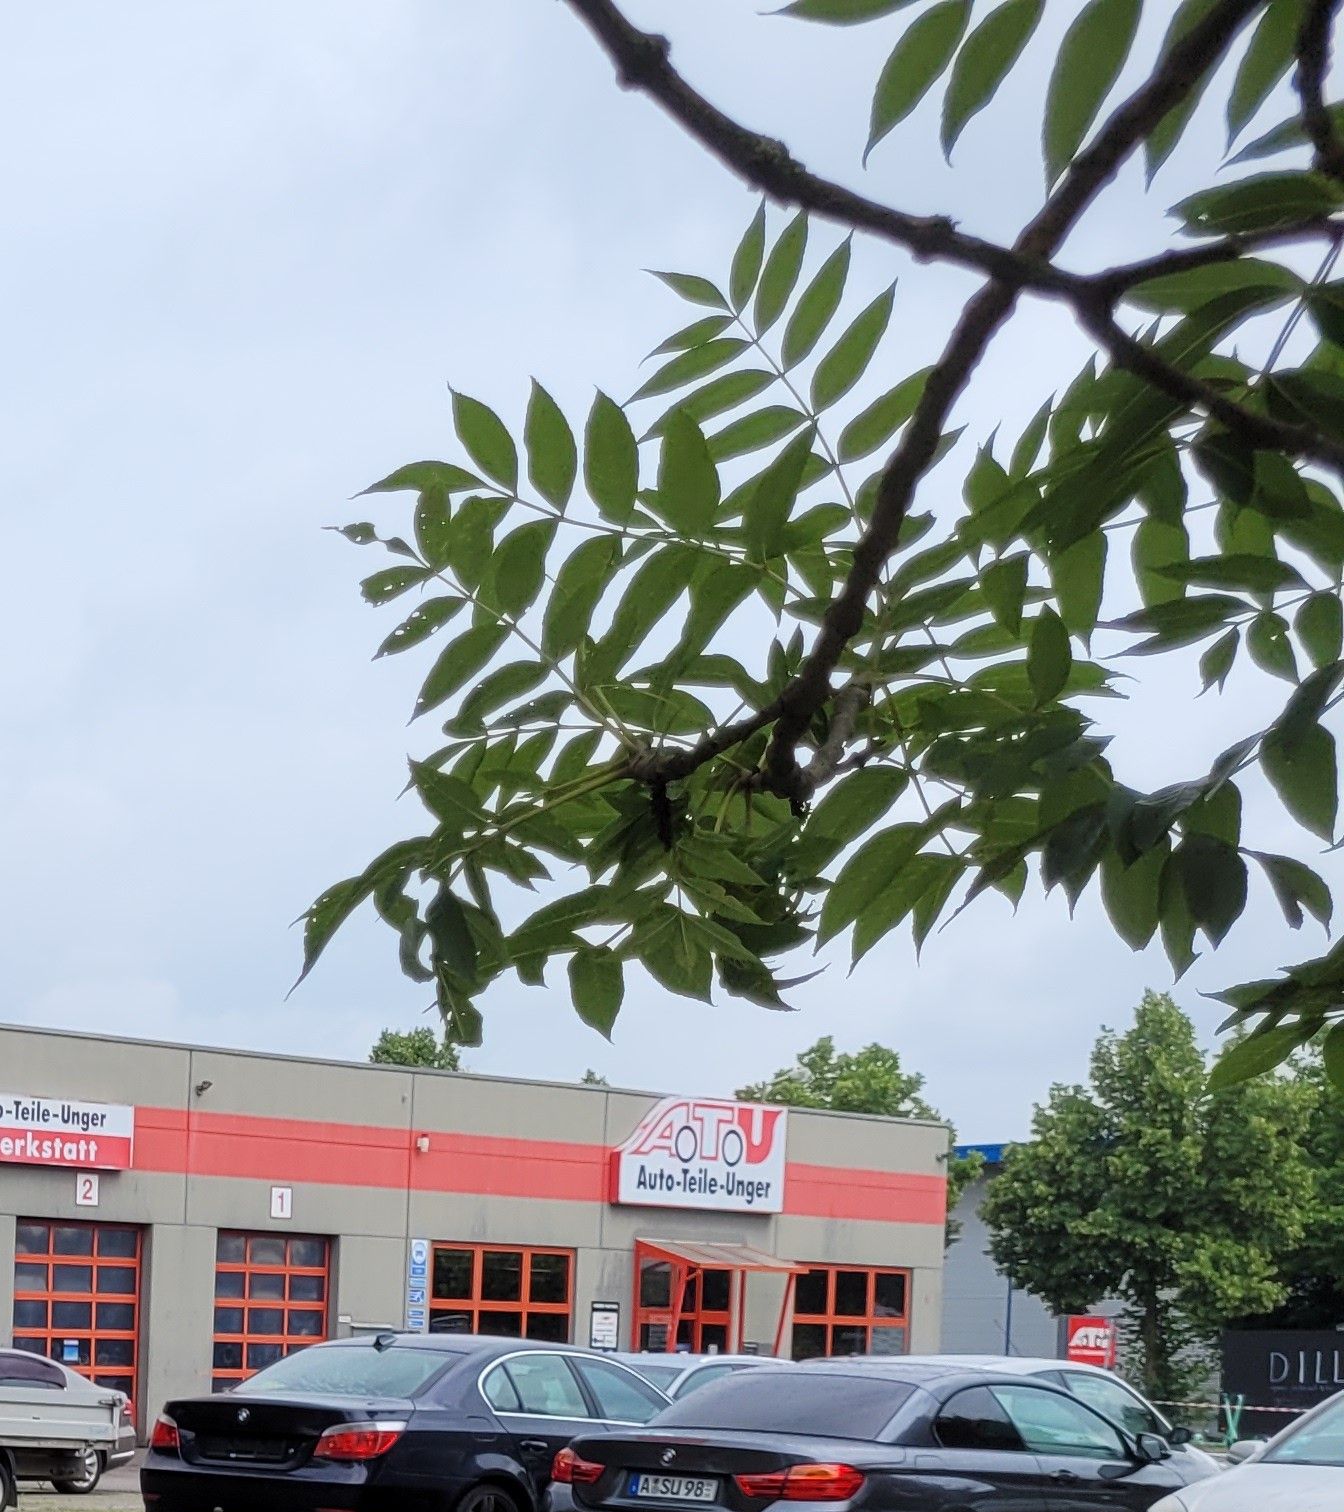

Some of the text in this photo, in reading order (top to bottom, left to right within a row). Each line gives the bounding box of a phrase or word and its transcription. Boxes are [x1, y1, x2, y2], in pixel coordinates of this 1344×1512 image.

[80, 1177, 95, 1201] 2
[636, 1165, 771, 1205] Auto-Teile-Unger
[277, 1190, 287, 1213] 1
[660, 1479, 682, 1495] SU
[684, 1480, 705, 1497] 98
